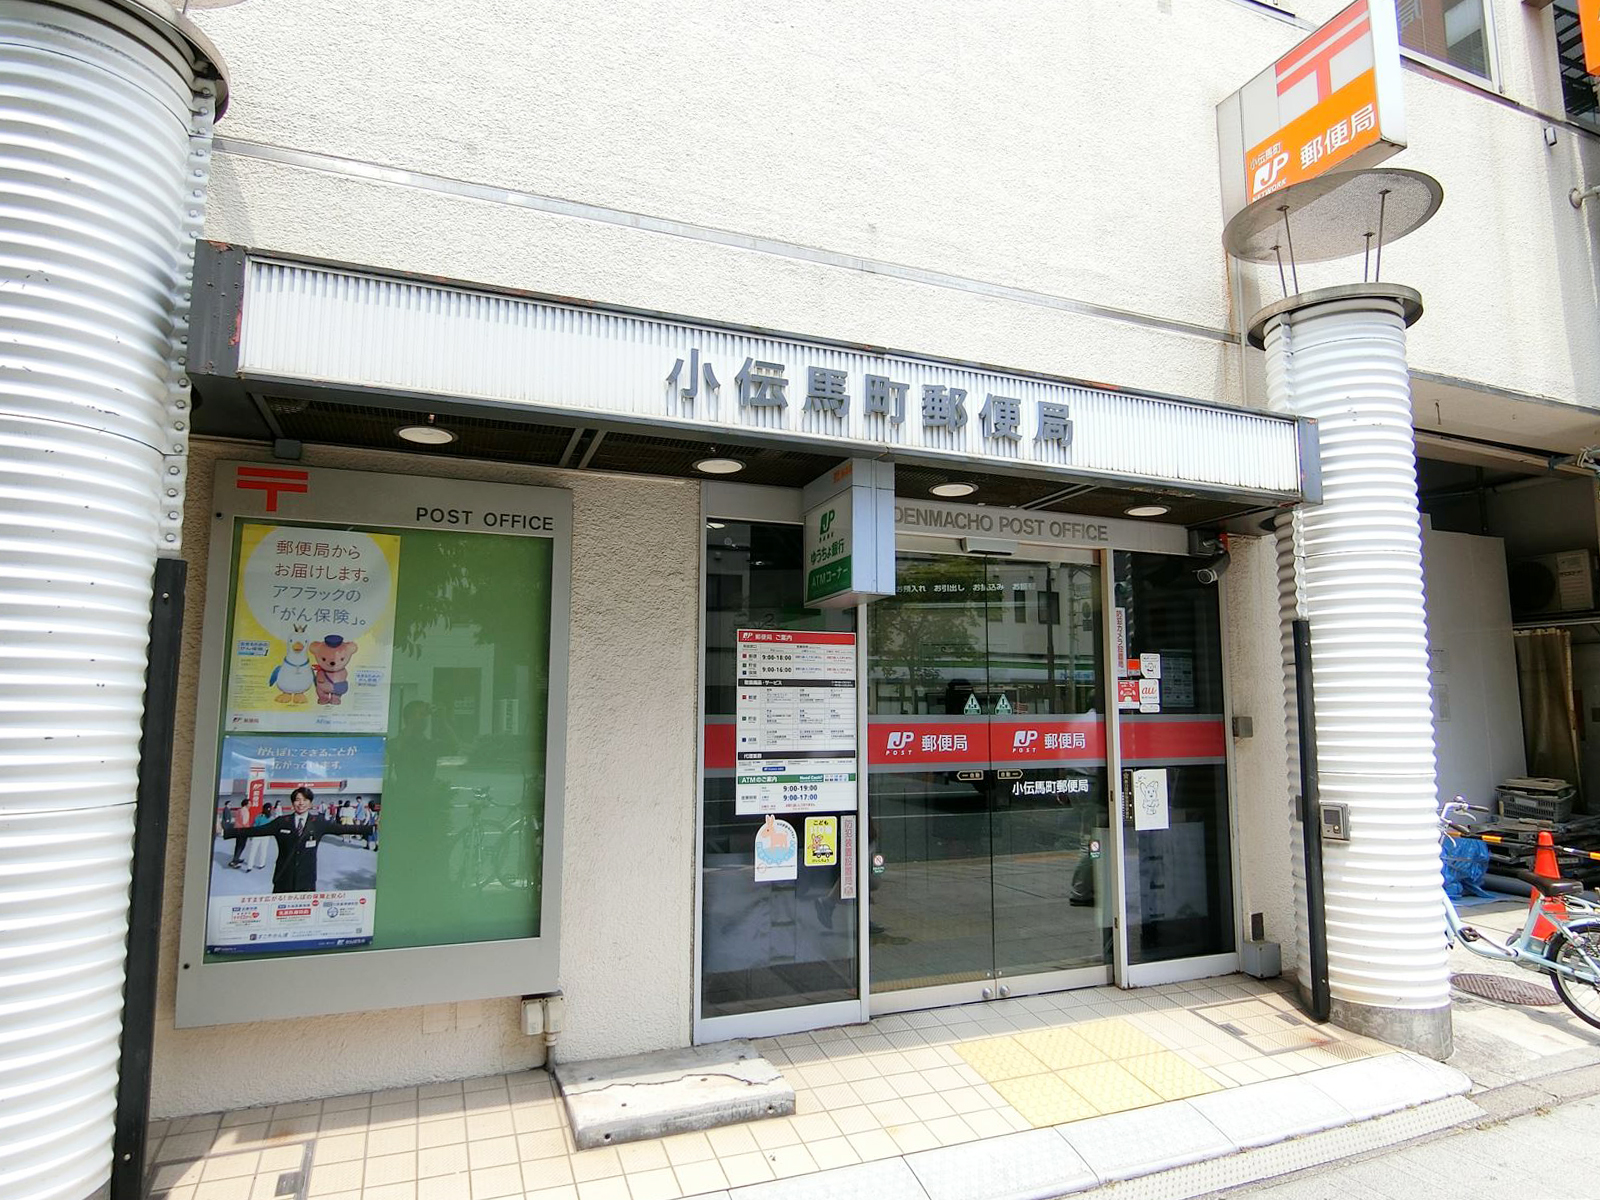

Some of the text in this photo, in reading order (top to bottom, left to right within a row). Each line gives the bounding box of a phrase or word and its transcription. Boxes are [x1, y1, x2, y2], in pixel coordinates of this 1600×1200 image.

[1300, 103, 1376, 170] 郵便局
[666, 347, 1074, 447] 小伝馬町郵便局
[416, 507, 554, 531] POST OFFICE
[999, 516, 1044, 536] POST
[1049, 521, 1109, 541] OFFICE
[276, 540, 361, 560] 郵便局から
[810, 538, 845, 566] ゆうちょ銀行
[274, 563, 370, 583] お届けします。
[811, 564, 849, 588] ATMコーナー
[272, 585, 361, 603] アフラックの
[934, 583, 965, 592] お引出し
[272, 605, 367, 626] 「がん保険」。
[886, 731, 968, 753] JP 郵便局
[1013, 730, 1086, 750] JP 郵便局
[1012, 779, 1089, 796] 小伝馬町郵便局
